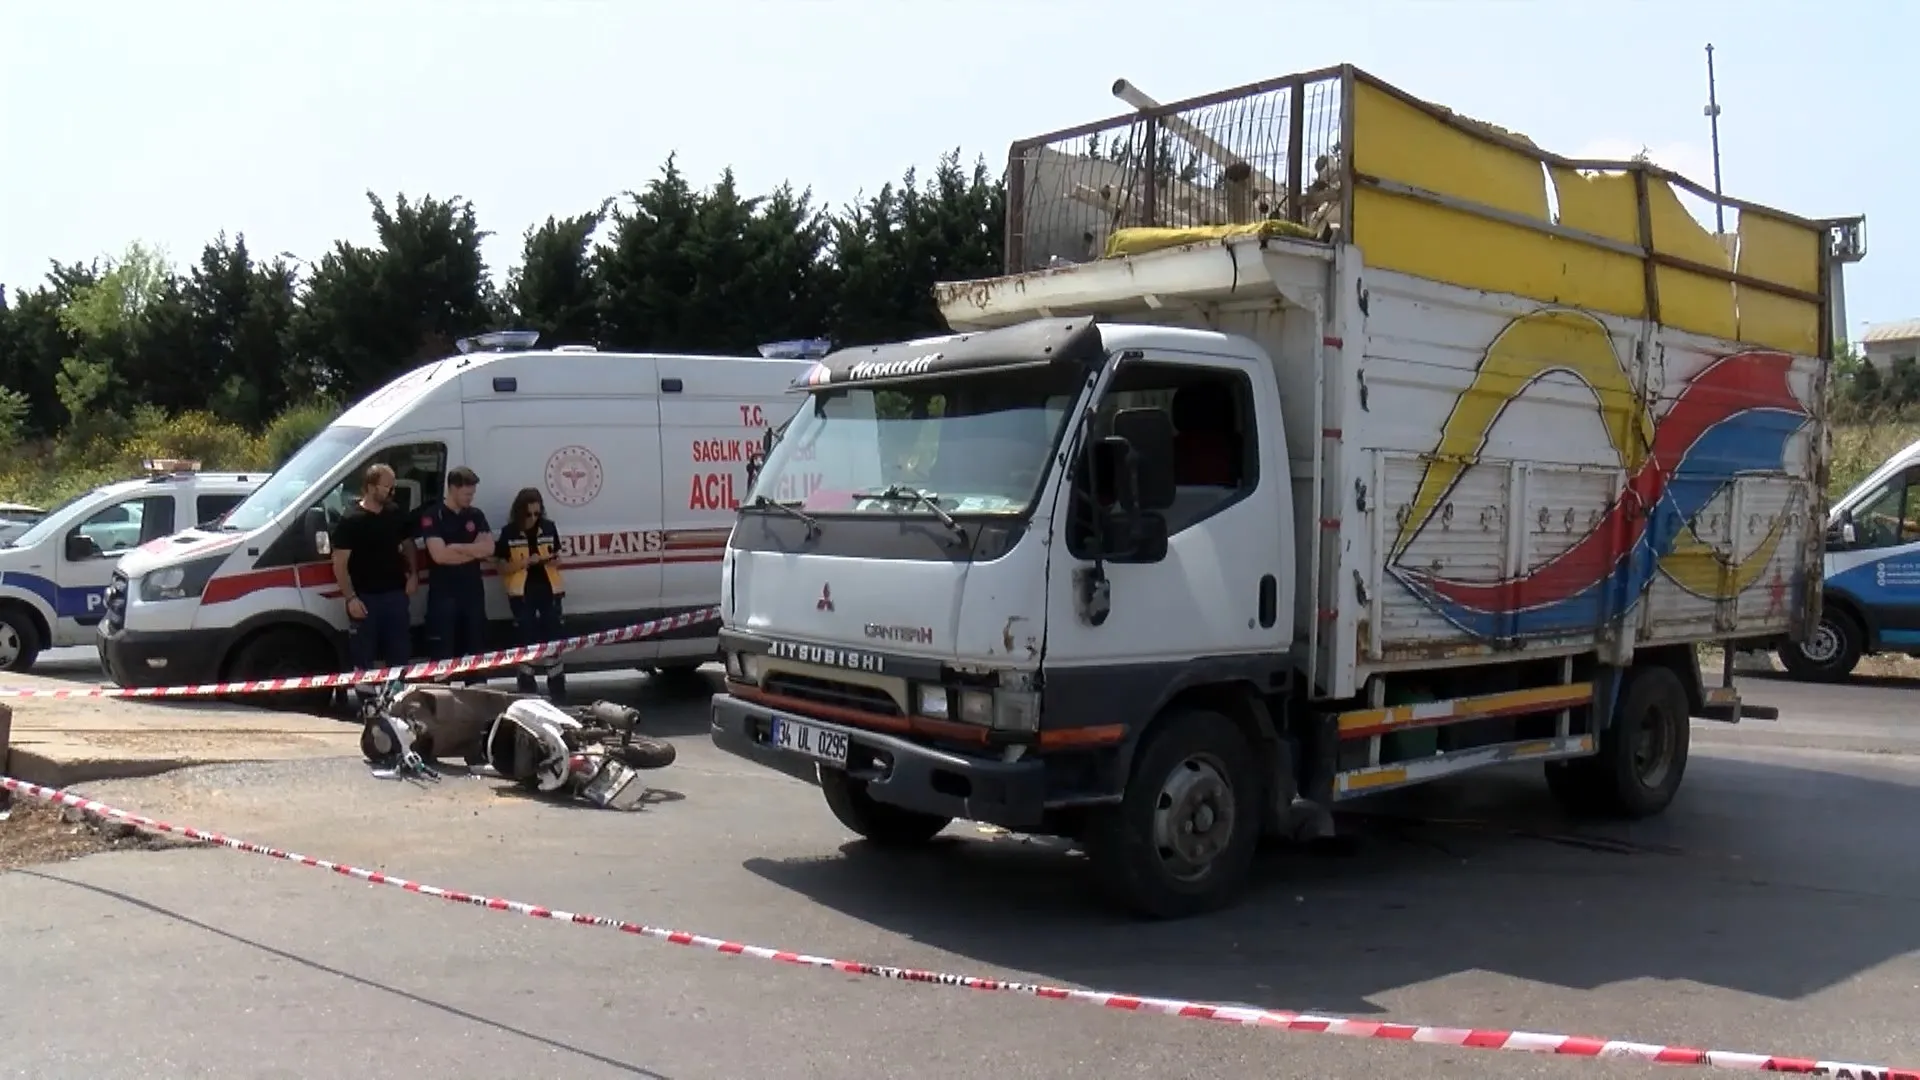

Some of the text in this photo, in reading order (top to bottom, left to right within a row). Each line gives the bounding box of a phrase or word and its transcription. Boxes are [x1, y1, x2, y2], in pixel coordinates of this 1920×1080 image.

[740, 405, 769, 427] T.C.
[693, 438, 742, 462] SAĞLIK
[558, 530, 661, 557] BULANS
[780, 722, 847, 760] 34 UL 0295
